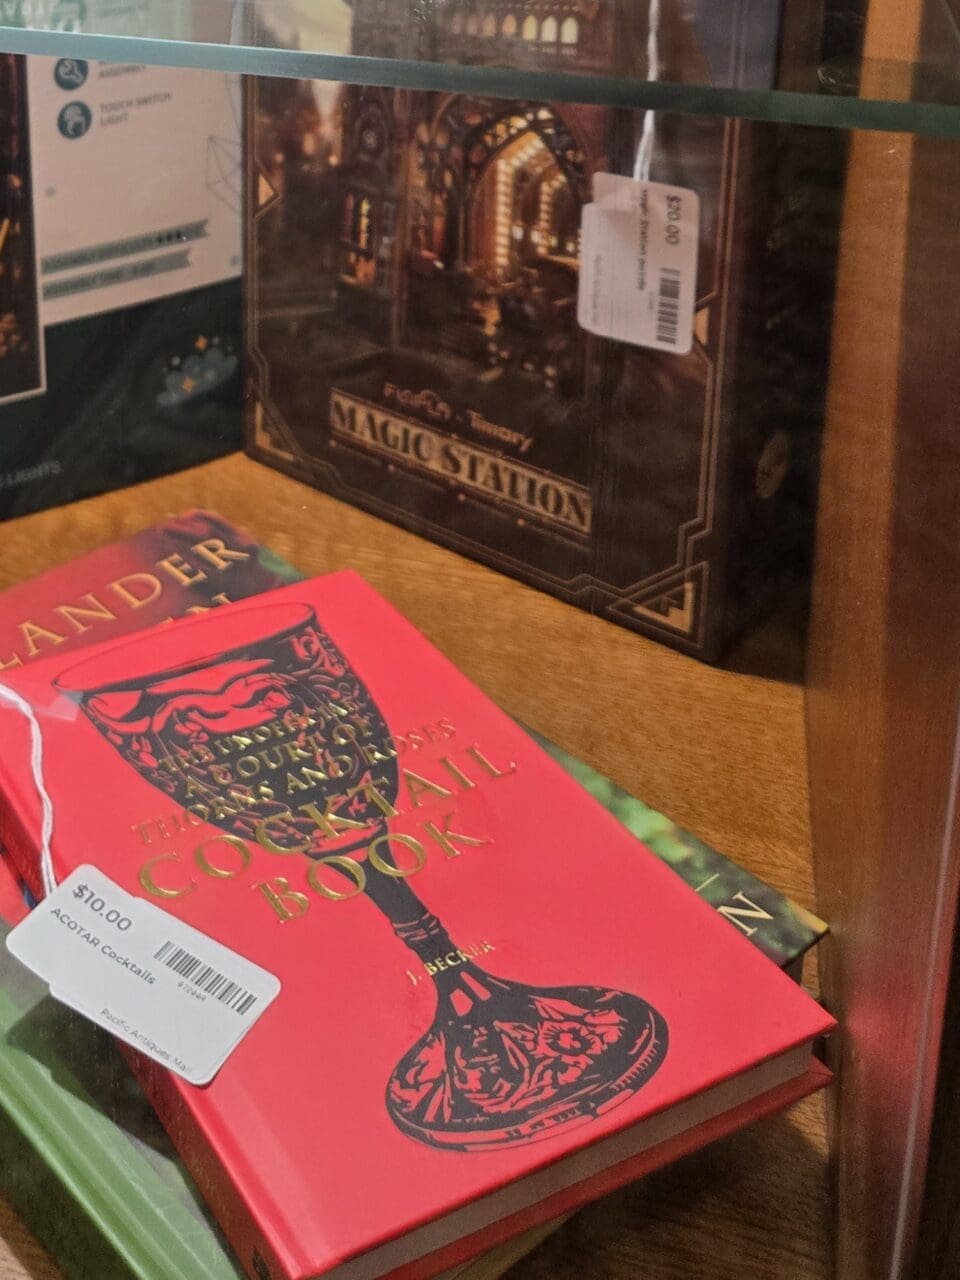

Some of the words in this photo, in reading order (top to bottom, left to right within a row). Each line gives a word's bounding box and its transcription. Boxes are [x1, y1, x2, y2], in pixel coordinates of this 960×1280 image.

[665, 194, 682, 246] $20.00
[333, 399, 439, 463] MAGIC
[440, 442, 588, 527] STATION
[131, 783, 275, 845] THORNS
[286, 754, 353, 795] AND
[365, 717, 456, 766] ROSES
[184, 774, 210, 799] A
[212, 732, 328, 786] COURT
[332, 718, 374, 746] OF
[139, 742, 521, 899] COCKTAIL
[251, 811, 495, 924] BOOK
[50, 907, 100, 949] ACOTAR
[100, 944, 157, 985] Cocktails
[72, 883, 132, 932] $10.00
[405, 969, 422, 987] J.
[423, 941, 496, 980] BECKER
[100, 1007, 130, 1033] Pacific
[131, 1029, 171, 1062] Antiques
